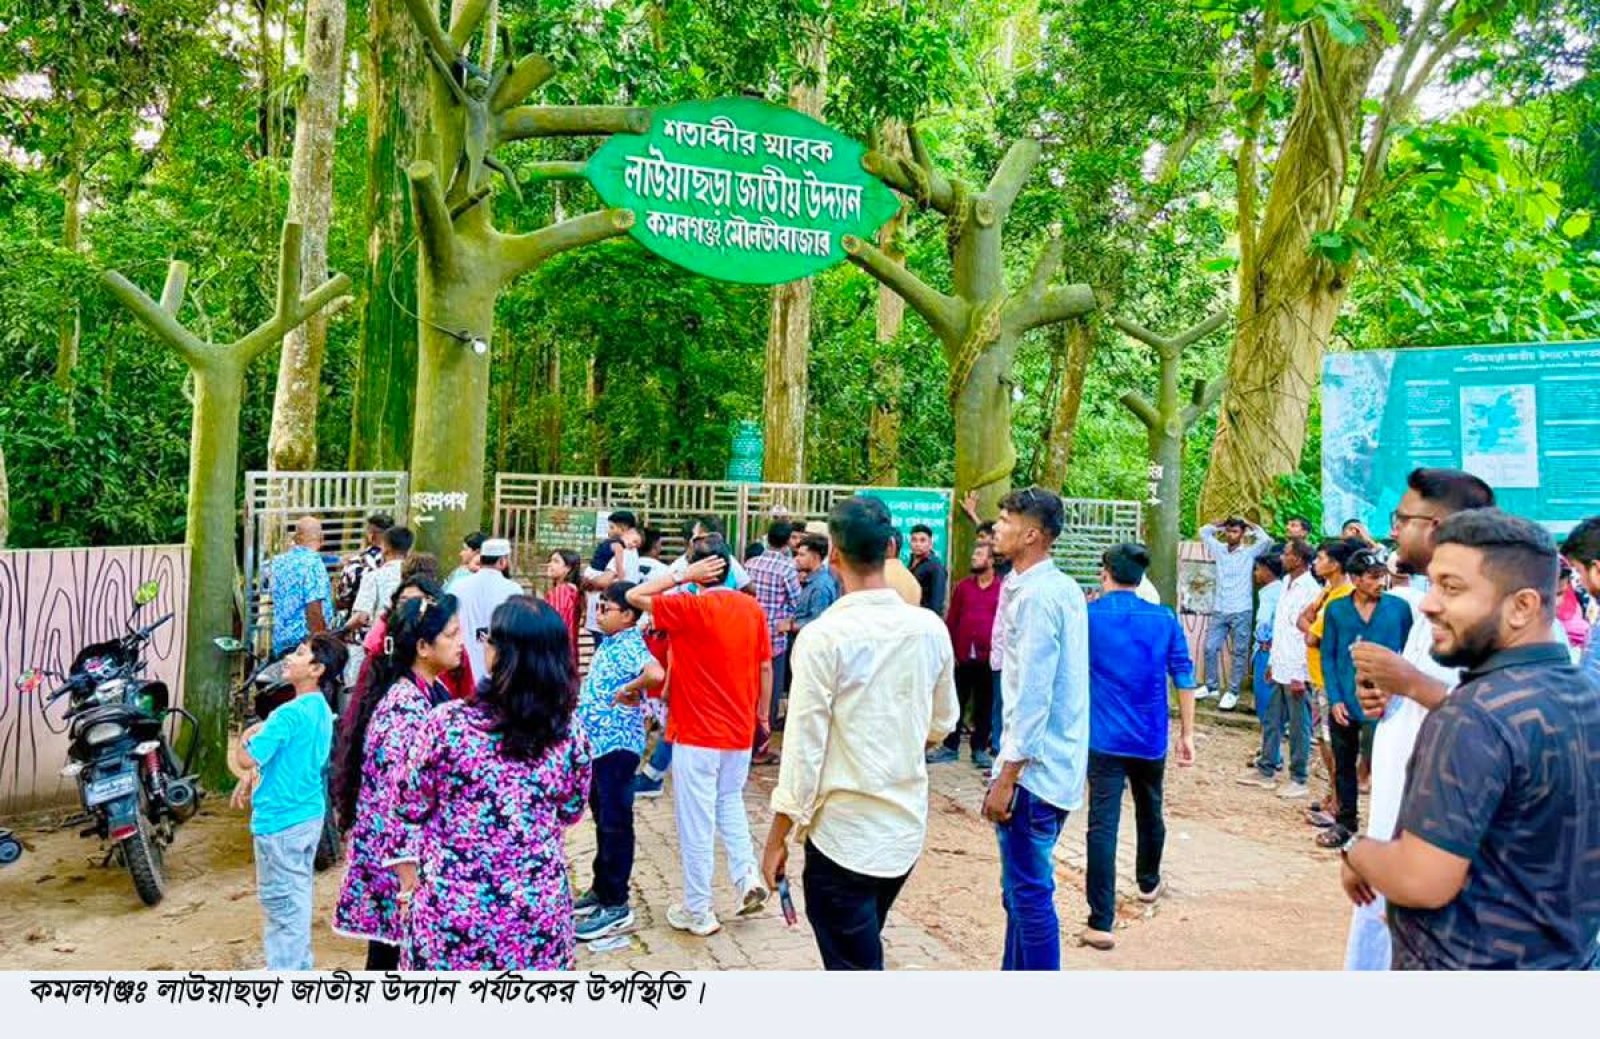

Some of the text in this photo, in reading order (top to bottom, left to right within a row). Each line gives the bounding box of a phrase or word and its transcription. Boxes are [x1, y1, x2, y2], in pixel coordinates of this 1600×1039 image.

[663, 115, 833, 164] শতাব্দীর স্মারক
[624, 146, 864, 222] লাউয়াছড়া জাতীয় উদ্যান
